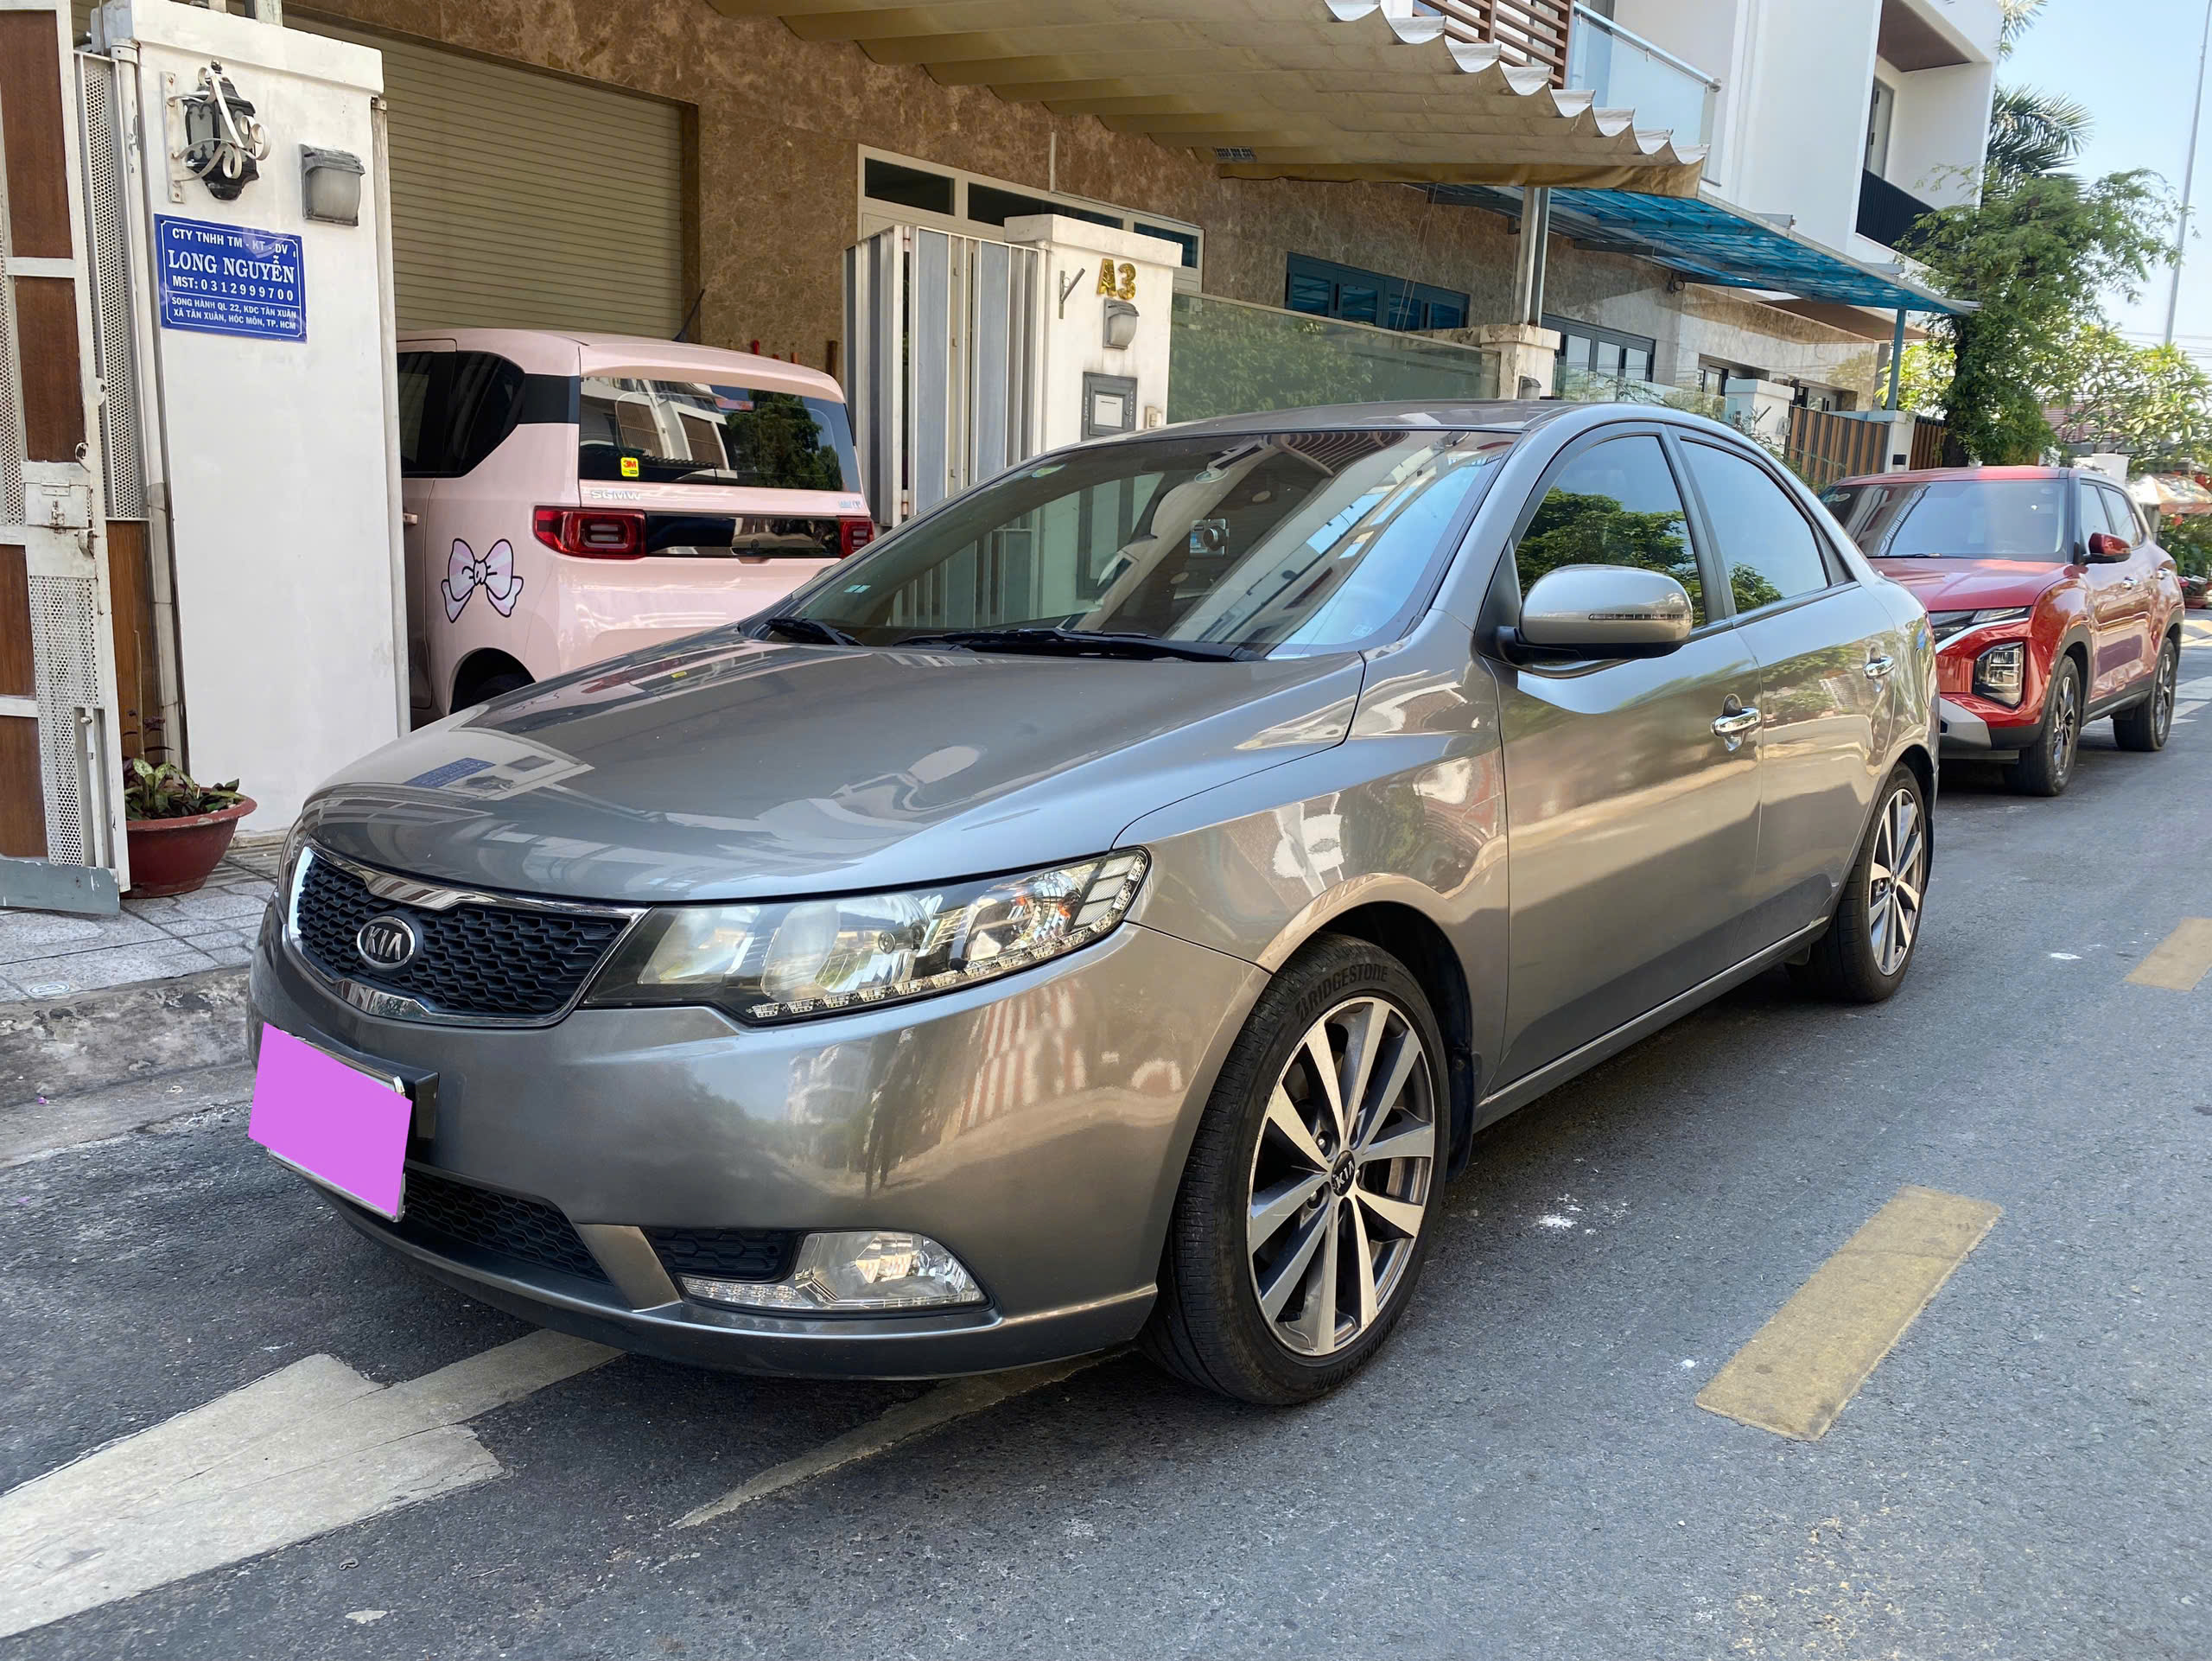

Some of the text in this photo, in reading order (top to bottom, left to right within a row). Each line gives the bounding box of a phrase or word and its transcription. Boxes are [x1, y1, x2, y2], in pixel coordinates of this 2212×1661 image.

[172, 227, 193, 241] CTY
[195, 231, 225, 245] TNHH
[226, 235, 243, 248] TM
[251, 239, 266, 251] KT
[168, 249, 296, 284] LONG NGUYỄN
[1096, 258, 1137, 300] A3
[172, 275, 294, 302] MST: 0312999700
[171, 296, 296, 319] SONG HÀNH QL 22, KDC TÂN XUÂN
[173, 307, 184, 317] XÃ
[186, 308, 202, 319] TÂN
[228, 313, 245, 324] HÓC
[266, 318, 278, 328] TP.
[279, 321, 296, 330] HCM
[623, 460, 637, 468] 3M
[590, 490, 641, 501] SGMW
[364, 925, 404, 961] KIA
[1295, 963, 1389, 1025] BRIDGESTONE
[1334, 1160, 1355, 1190] KIA
